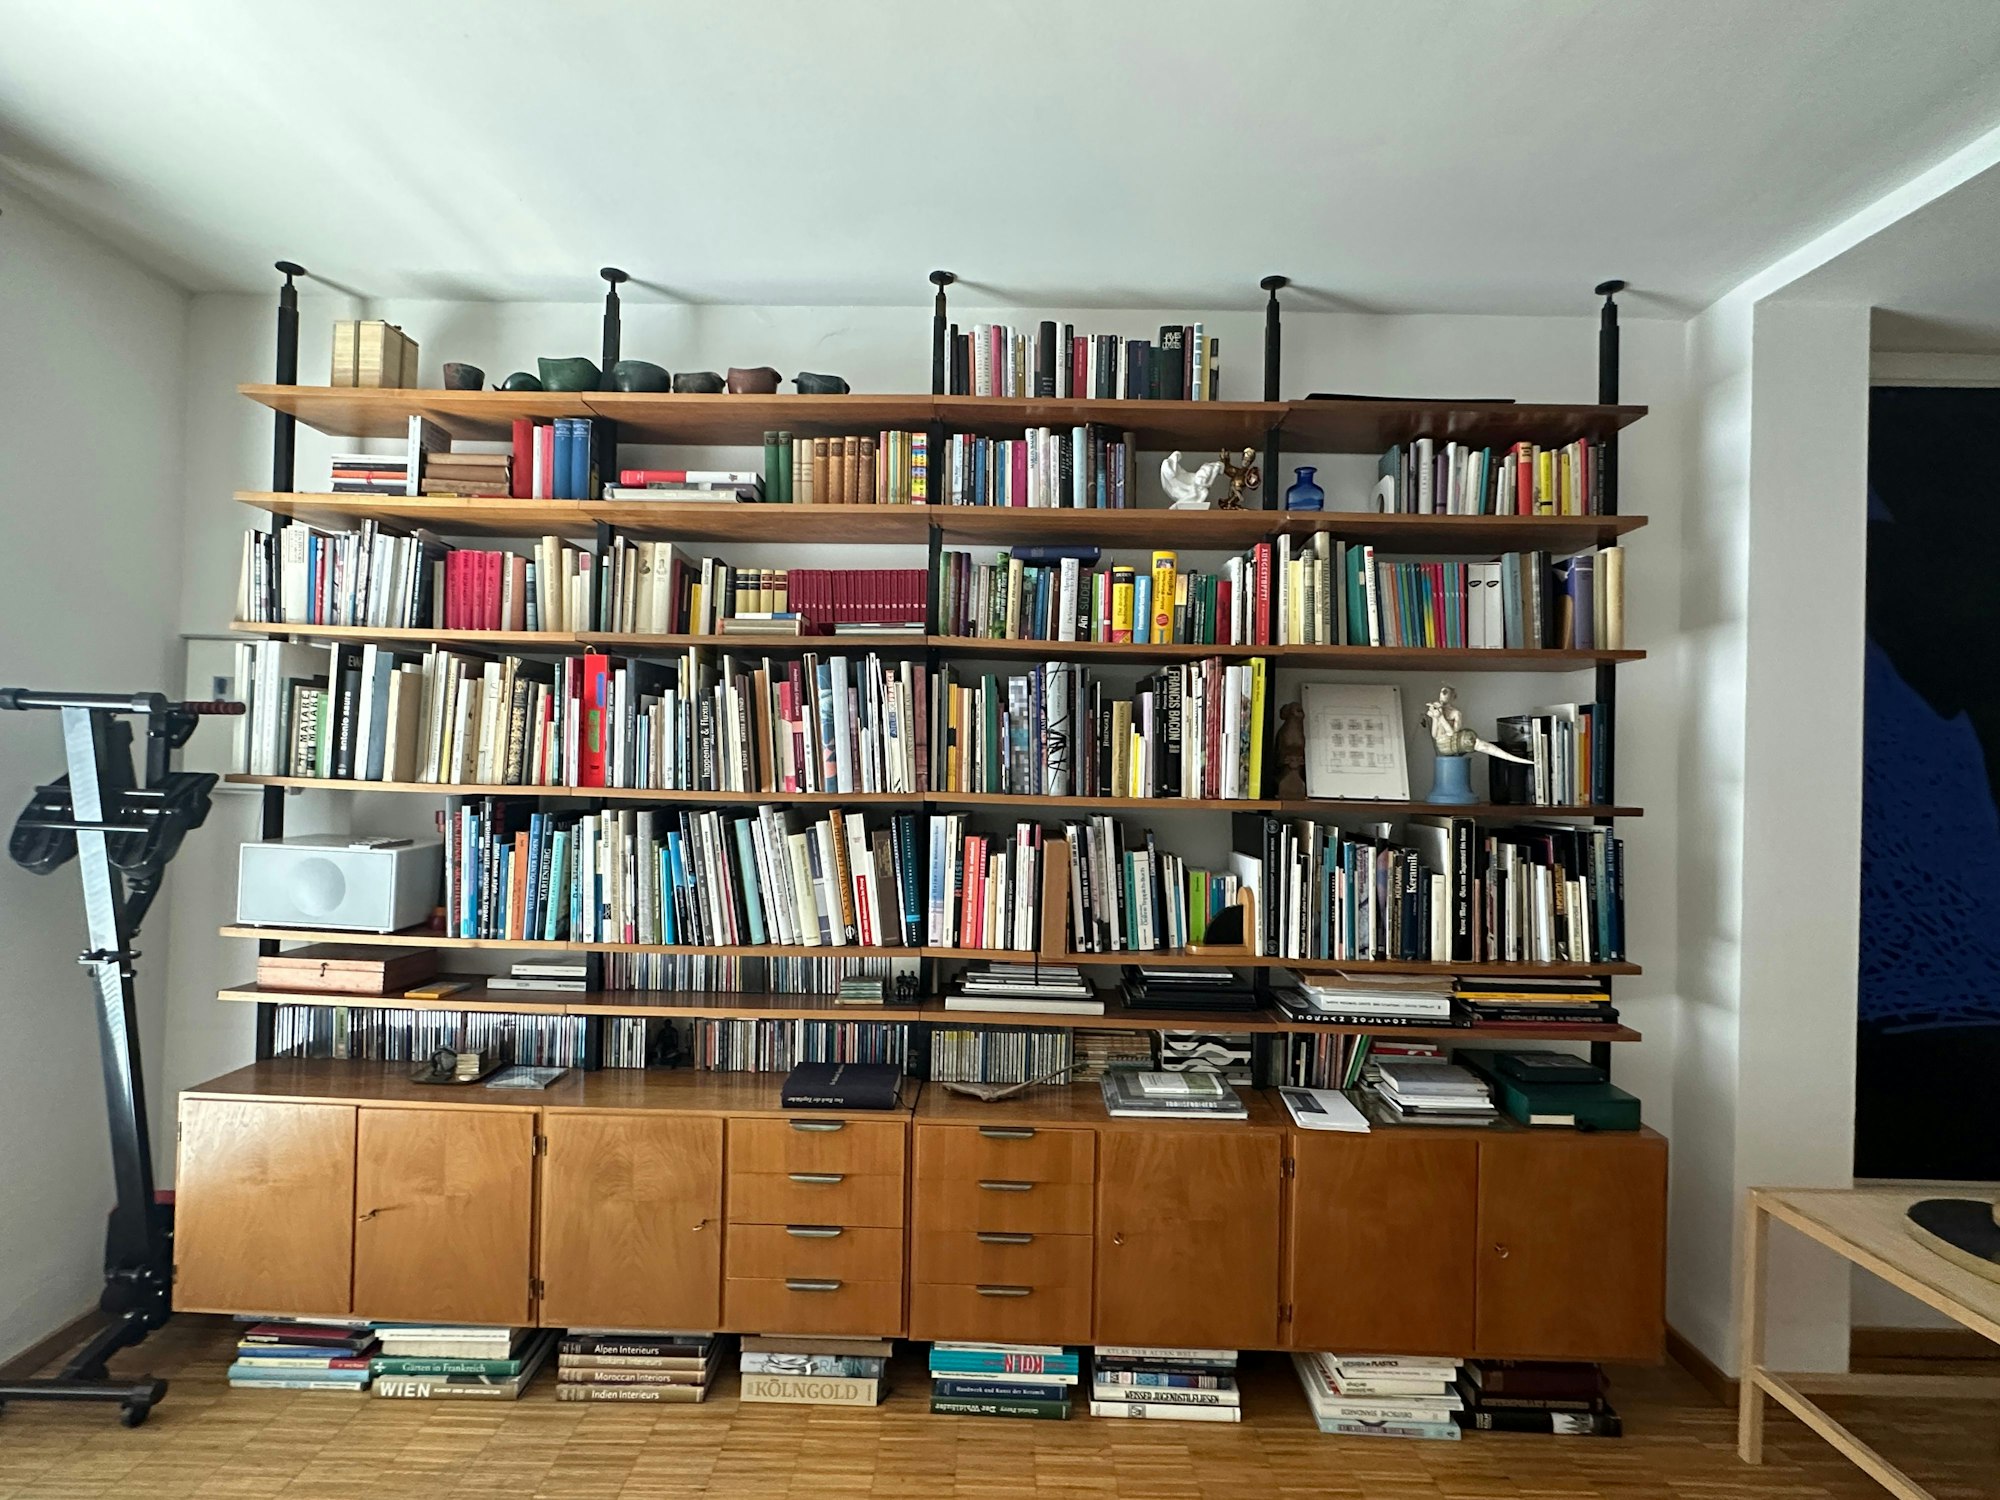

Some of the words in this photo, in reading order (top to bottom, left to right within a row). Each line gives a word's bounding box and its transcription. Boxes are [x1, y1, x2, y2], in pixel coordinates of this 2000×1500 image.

[1078, 615, 1089, 629] Ani
[1168, 670, 1181, 709] FRANCIS
[343, 691, 351, 716] saura
[700, 701, 709, 725] fluxus
[340, 717, 349, 751] antonio
[700, 725, 709, 735] &
[1168, 712, 1181, 741] BACON
[701, 735, 711, 778] happening
[540, 847, 552, 901] MARIENBURG
[1406, 853, 1418, 893] Keramik
[528, 888, 536, 910] VILLEN
[594, 1344, 618, 1356] Alpen
[620, 1345, 659, 1355] Interieurs
[402, 1362, 431, 1372] Gärten
[433, 1363, 440, 1372] in
[442, 1362, 486, 1372] Frankreich
[594, 1372, 636, 1382] Moroccan
[637, 1374, 671, 1383] Interiors
[380, 1381, 430, 1397] WIEN
[591, 1390, 617, 1400] Indien
[619, 1390, 659, 1400] Interieurs
[754, 1378, 858, 1400] KÖLNGOLD
[982, 1405, 996, 1413] Der
